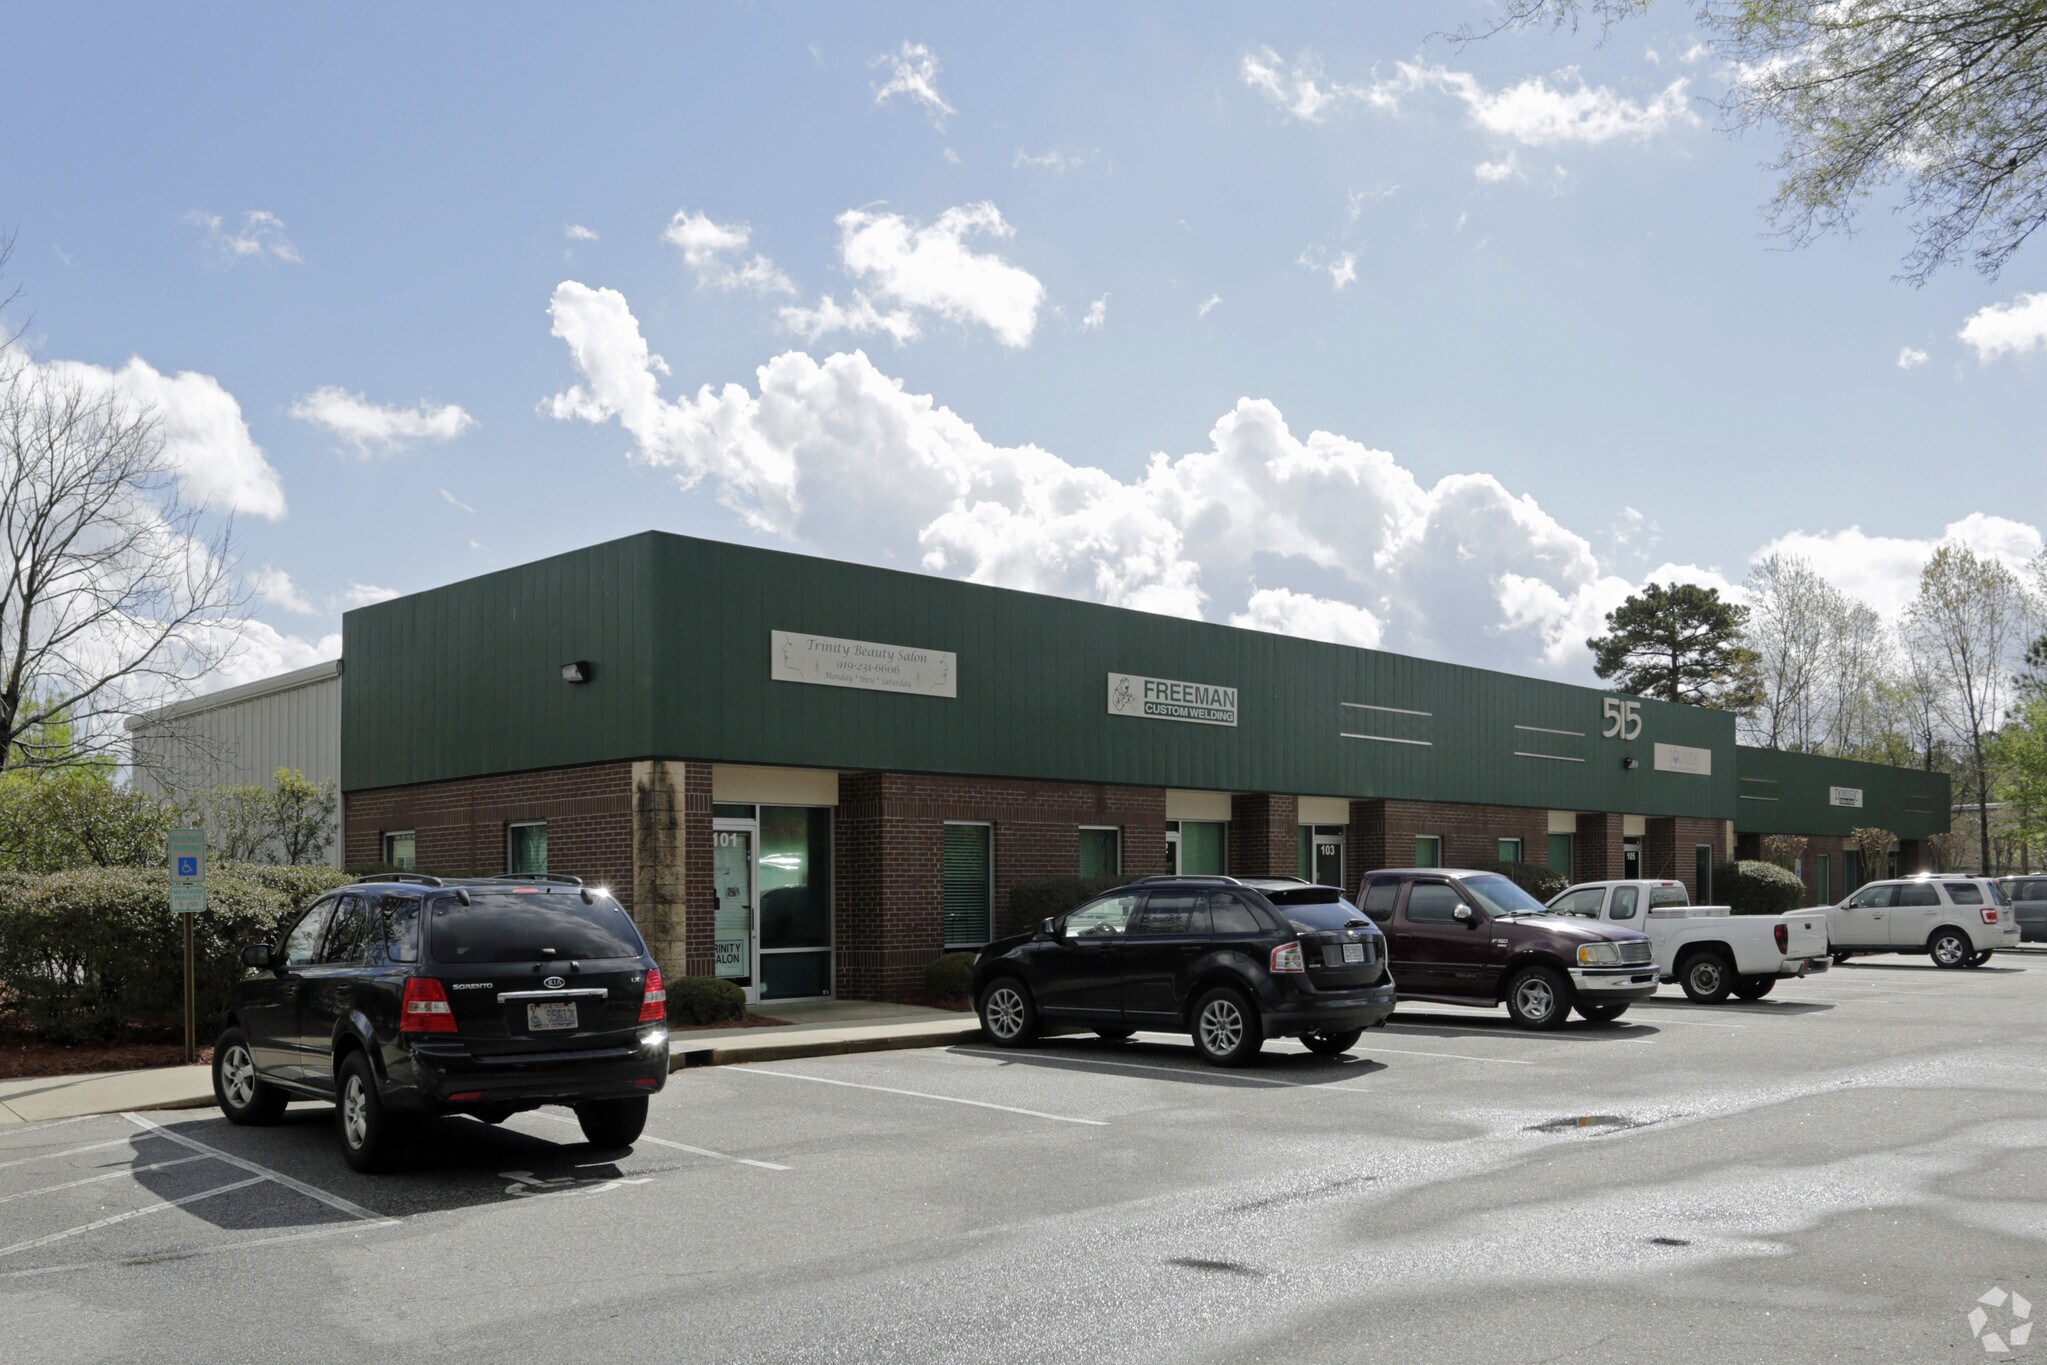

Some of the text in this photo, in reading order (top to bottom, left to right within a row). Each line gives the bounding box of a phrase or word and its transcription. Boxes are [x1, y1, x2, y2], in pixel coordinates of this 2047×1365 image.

[806, 639, 929, 664] Trinity Beauty Salon
[836, 661, 901, 675] 919-231-6606
[824, 671, 854, 684] Monday
[880, 678, 912, 689] Saturday
[1144, 679, 1235, 709] FREEMAN
[1145, 703, 1234, 722] CUSTOM WELDING
[1602, 697, 1642, 741] 515
[713, 832, 738, 848] 101
[1320, 844, 1336, 856] 103
[1626, 852, 1636, 861] 105
[452, 983, 493, 991] SORENTO
